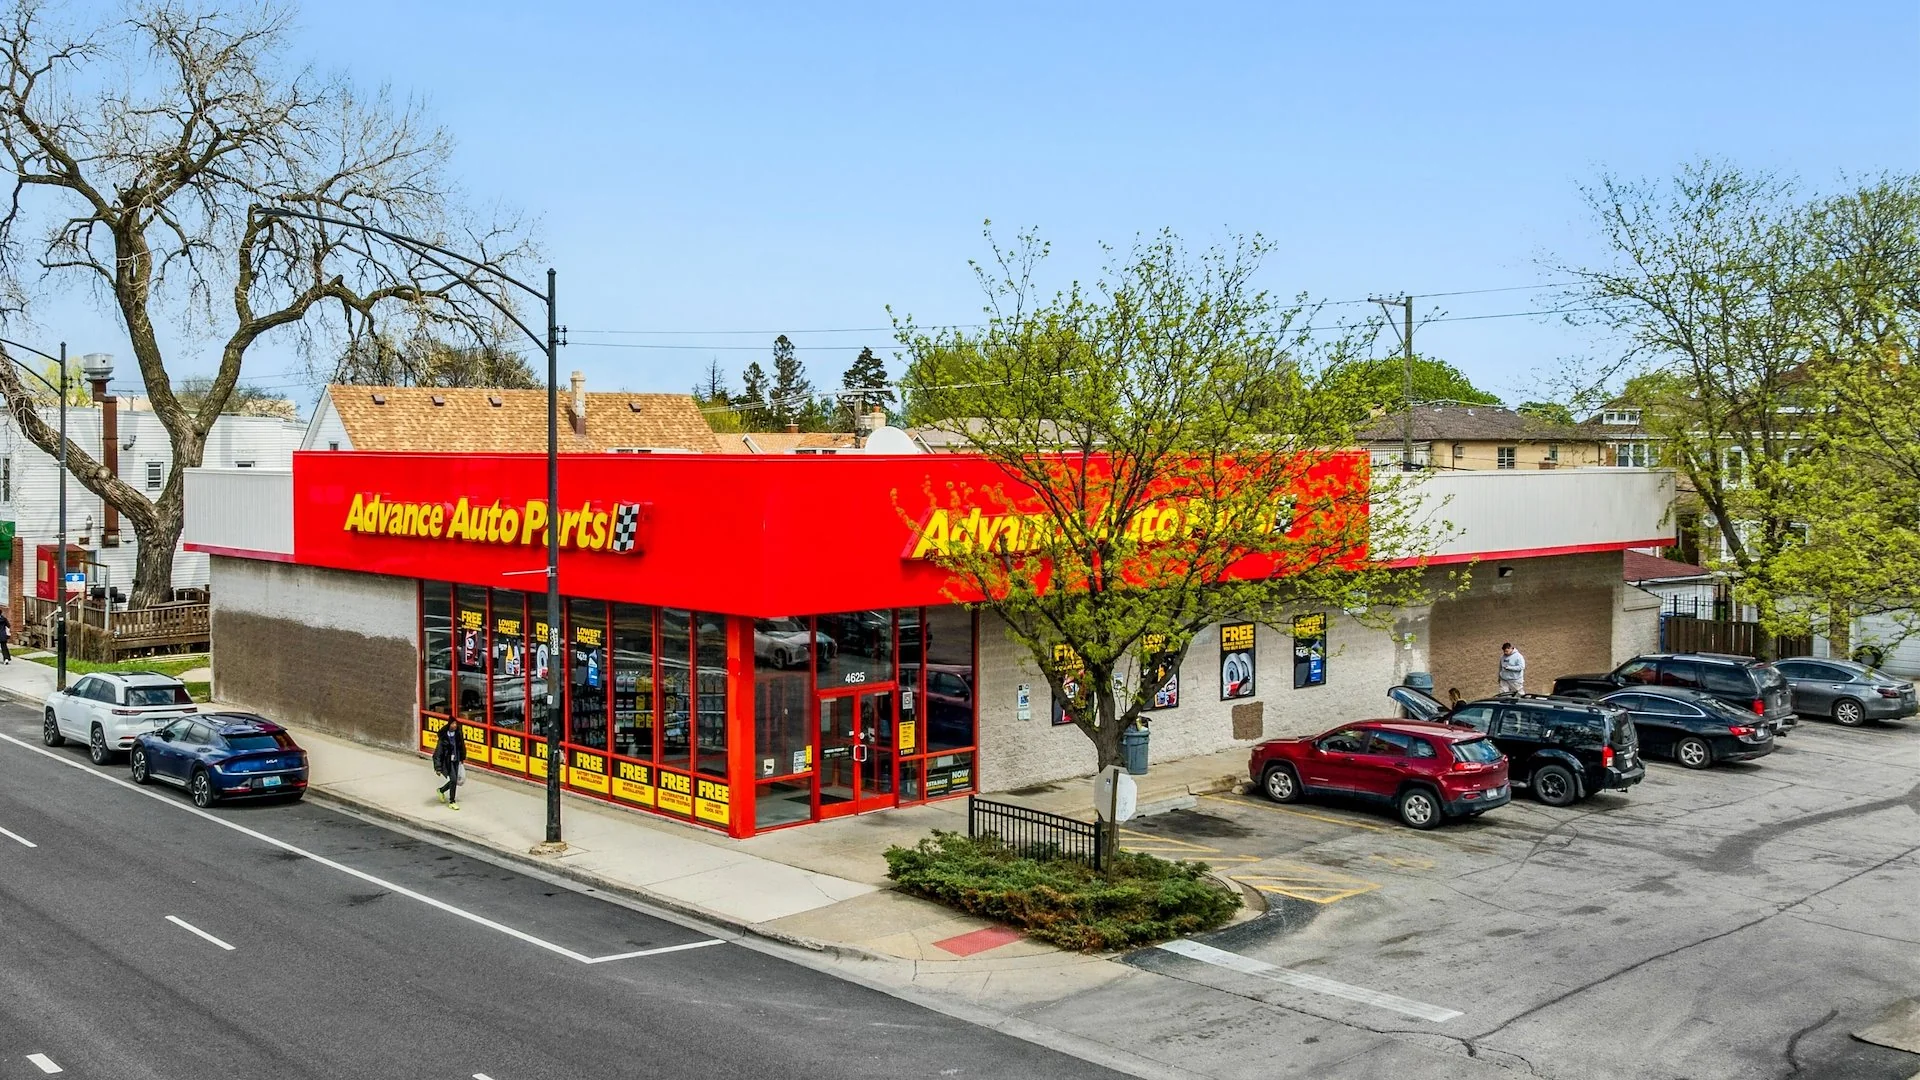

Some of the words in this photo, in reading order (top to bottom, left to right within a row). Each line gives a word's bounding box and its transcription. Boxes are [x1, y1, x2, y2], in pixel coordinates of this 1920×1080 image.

[344, 493, 443, 537] Advance
[446, 497, 519, 543] Auto
[461, 610, 482, 625] FREE
[498, 619, 520, 629] LOWEST
[536, 622, 548, 636] FR
[577, 626, 601, 638] LOWEST
[1222, 624, 1254, 642] FREE
[845, 671, 865, 683] 4625
[428, 717, 448, 733] FRE
[462, 725, 484, 743] FREE
[498, 733, 521, 752] FREE
[536, 742, 548, 759] FR
[576, 752, 603, 773] FREE
[620, 762, 648, 783] FREE
[952, 769, 969, 778] NOW
[661, 771, 690, 793] FREE
[698, 780, 729, 803] FREE
